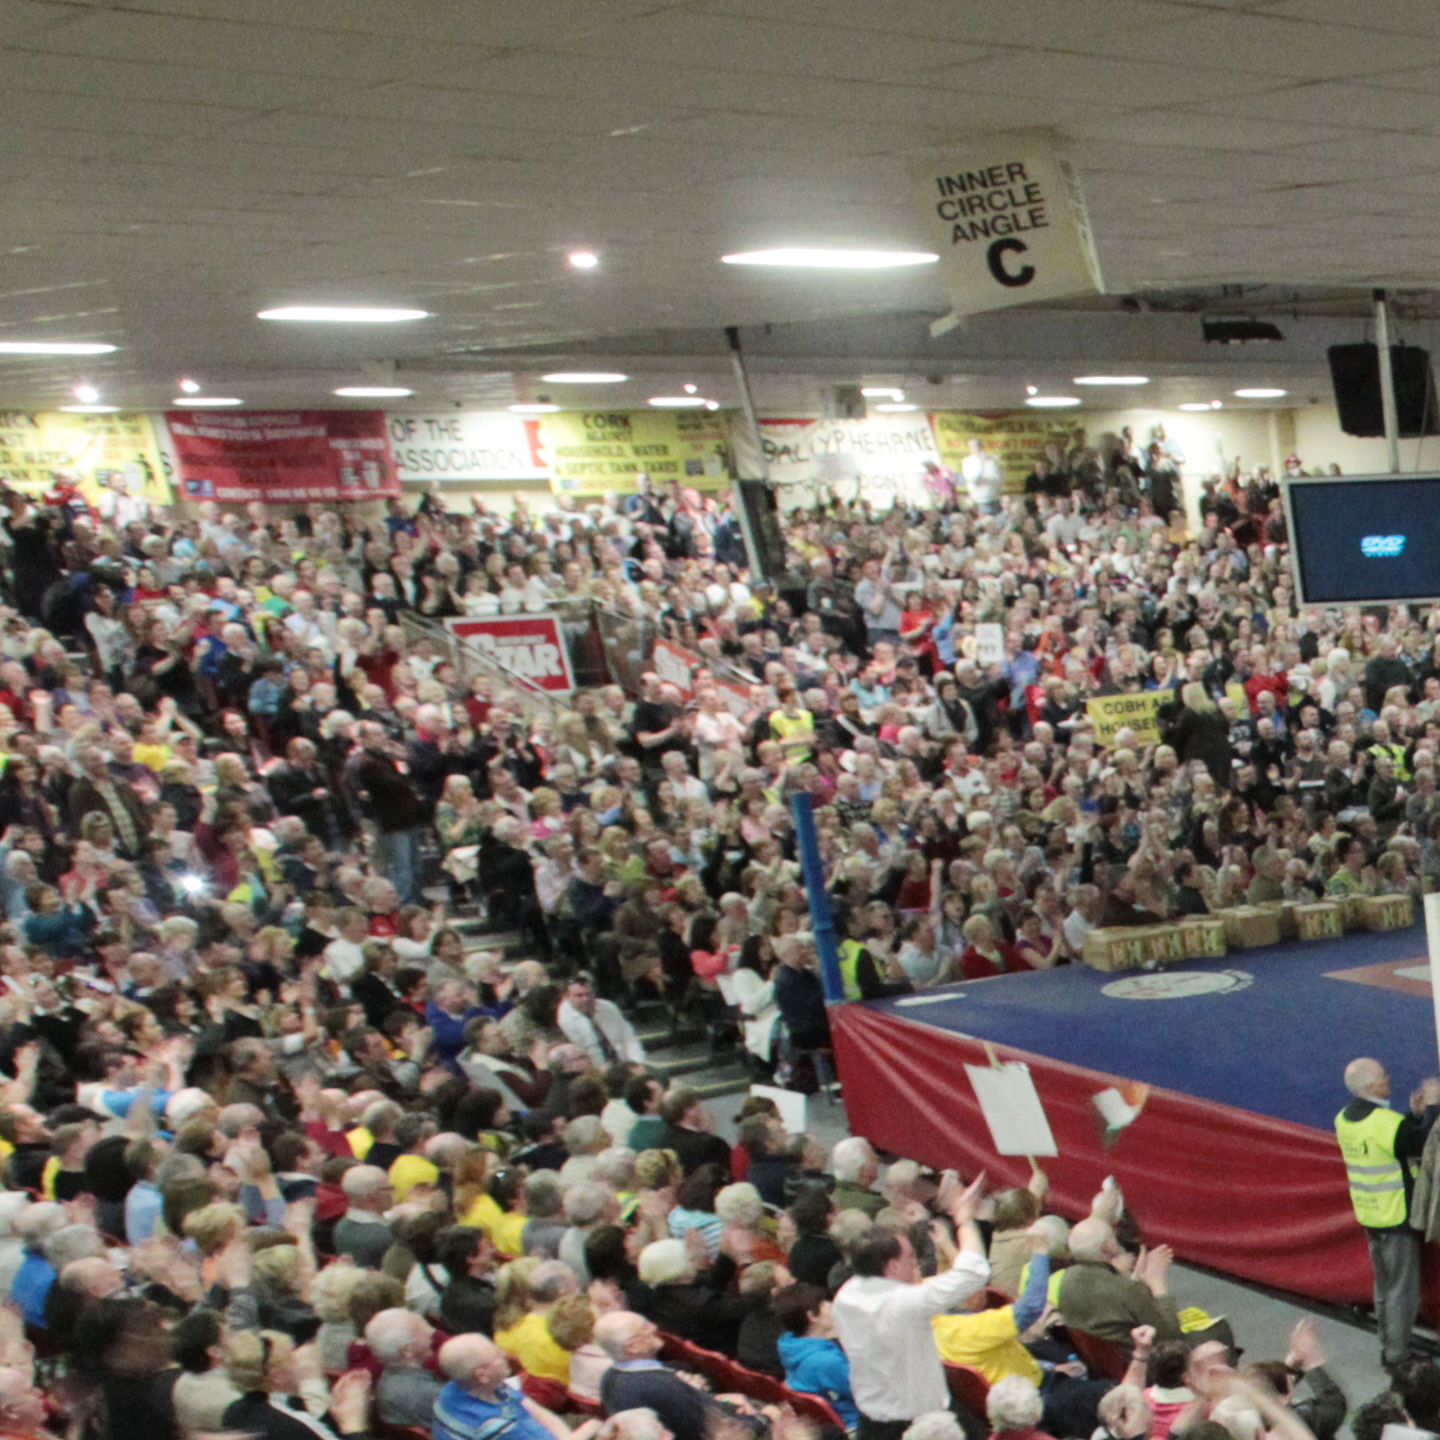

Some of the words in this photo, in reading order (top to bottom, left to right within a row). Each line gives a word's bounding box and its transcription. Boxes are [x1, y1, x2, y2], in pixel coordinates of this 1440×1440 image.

[936, 162, 1028, 196] INNER
[936, 183, 1044, 221] CIRCLE
[952, 207, 1050, 245] ANGLE
[987, 238, 1035, 288] C
[391, 419, 416, 441] OF
[424, 419, 462, 441] THE
[584, 414, 631, 428] CORK
[395, 449, 524, 471] ASSOCIATION
[1103, 698, 1146, 715] COBH
[1101, 717, 1157, 735] HOUSE
